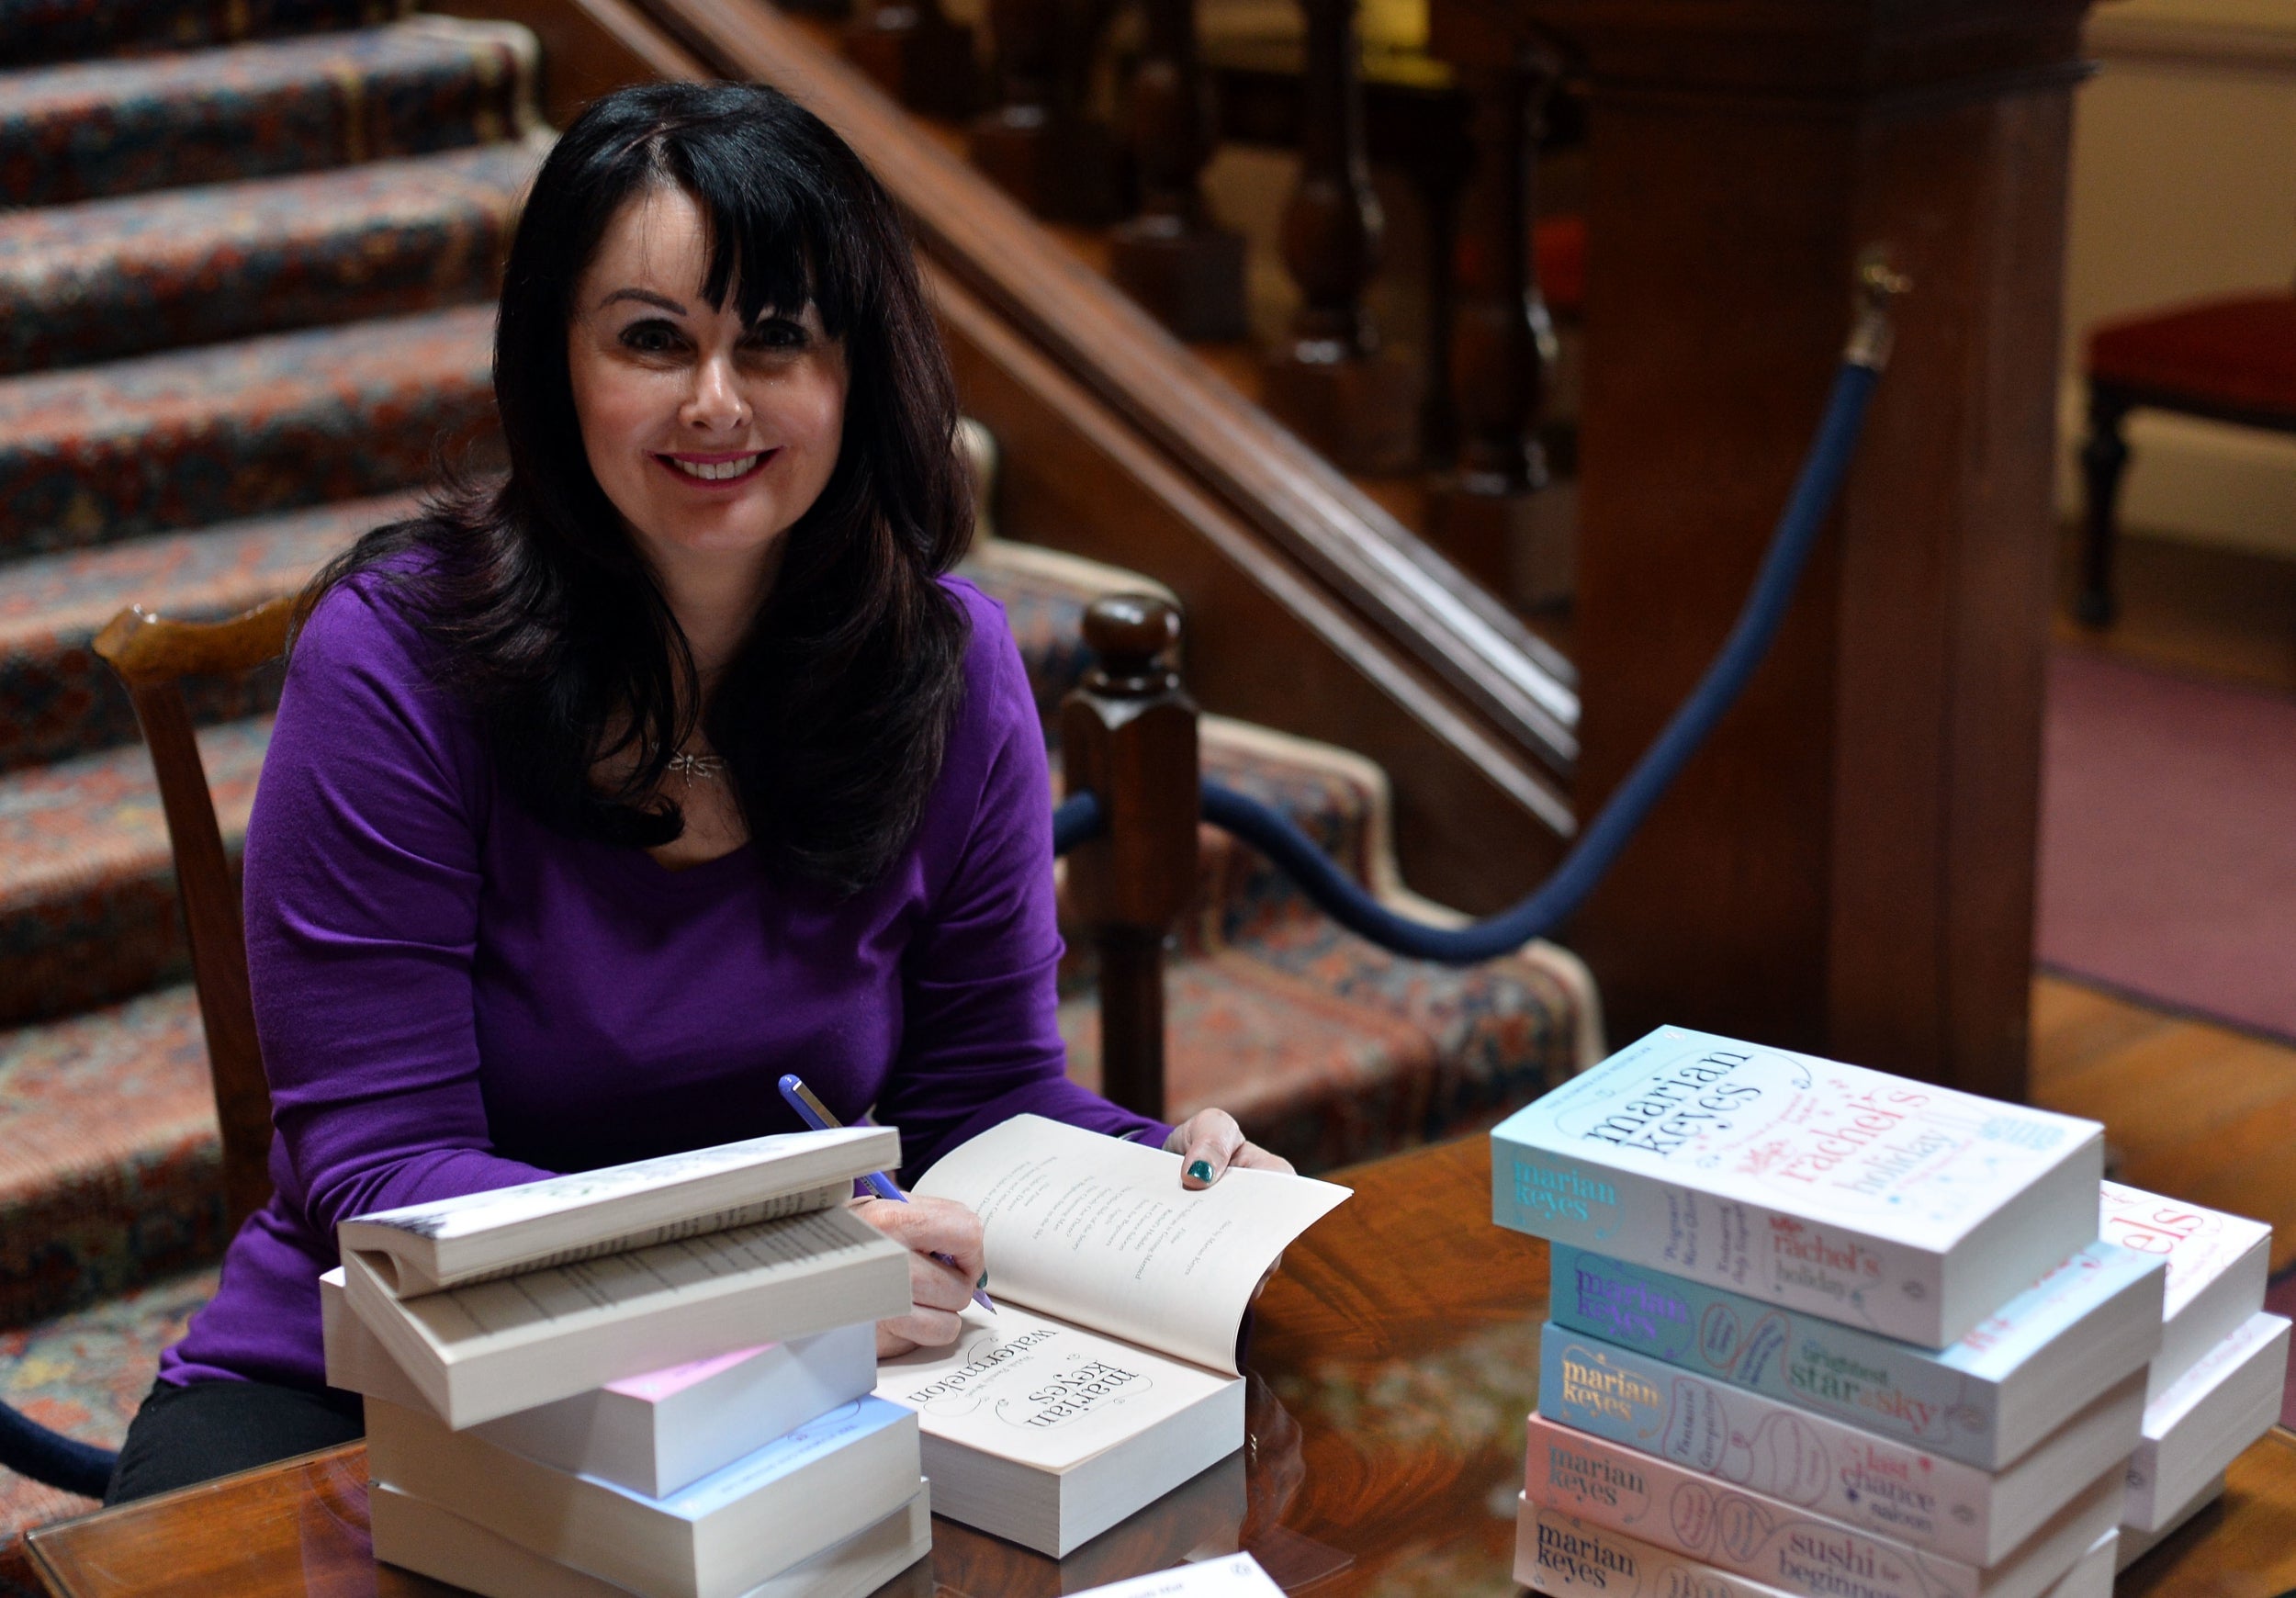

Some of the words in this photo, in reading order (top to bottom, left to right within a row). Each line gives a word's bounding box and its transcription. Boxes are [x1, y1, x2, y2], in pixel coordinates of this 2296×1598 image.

[1582, 1051, 1753, 1145] marian
[1623, 1083, 1761, 1155] keyes
[1779, 1089, 1930, 1183] rachel's
[1514, 1161, 1615, 1205] marian
[1514, 1181, 1589, 1221] keyes
[2109, 1207, 2203, 1256] els
[1575, 1267, 1686, 1323] marian
[1577, 1290, 1657, 1339] keyes
[906, 1328, 1059, 1403] watermelon
[1029, 1359, 1118, 1405] keyes
[1563, 1359, 1660, 1409] marian
[1024, 1367, 1140, 1427] marian
[1563, 1379, 1633, 1422] keyes
[1548, 1445, 1644, 1494] marian
[1549, 1469, 1617, 1506] keyes
[1537, 1522, 1635, 1578] marian
[1537, 1543, 1607, 1590] keyes
[1790, 1533, 1874, 1579] sushi
